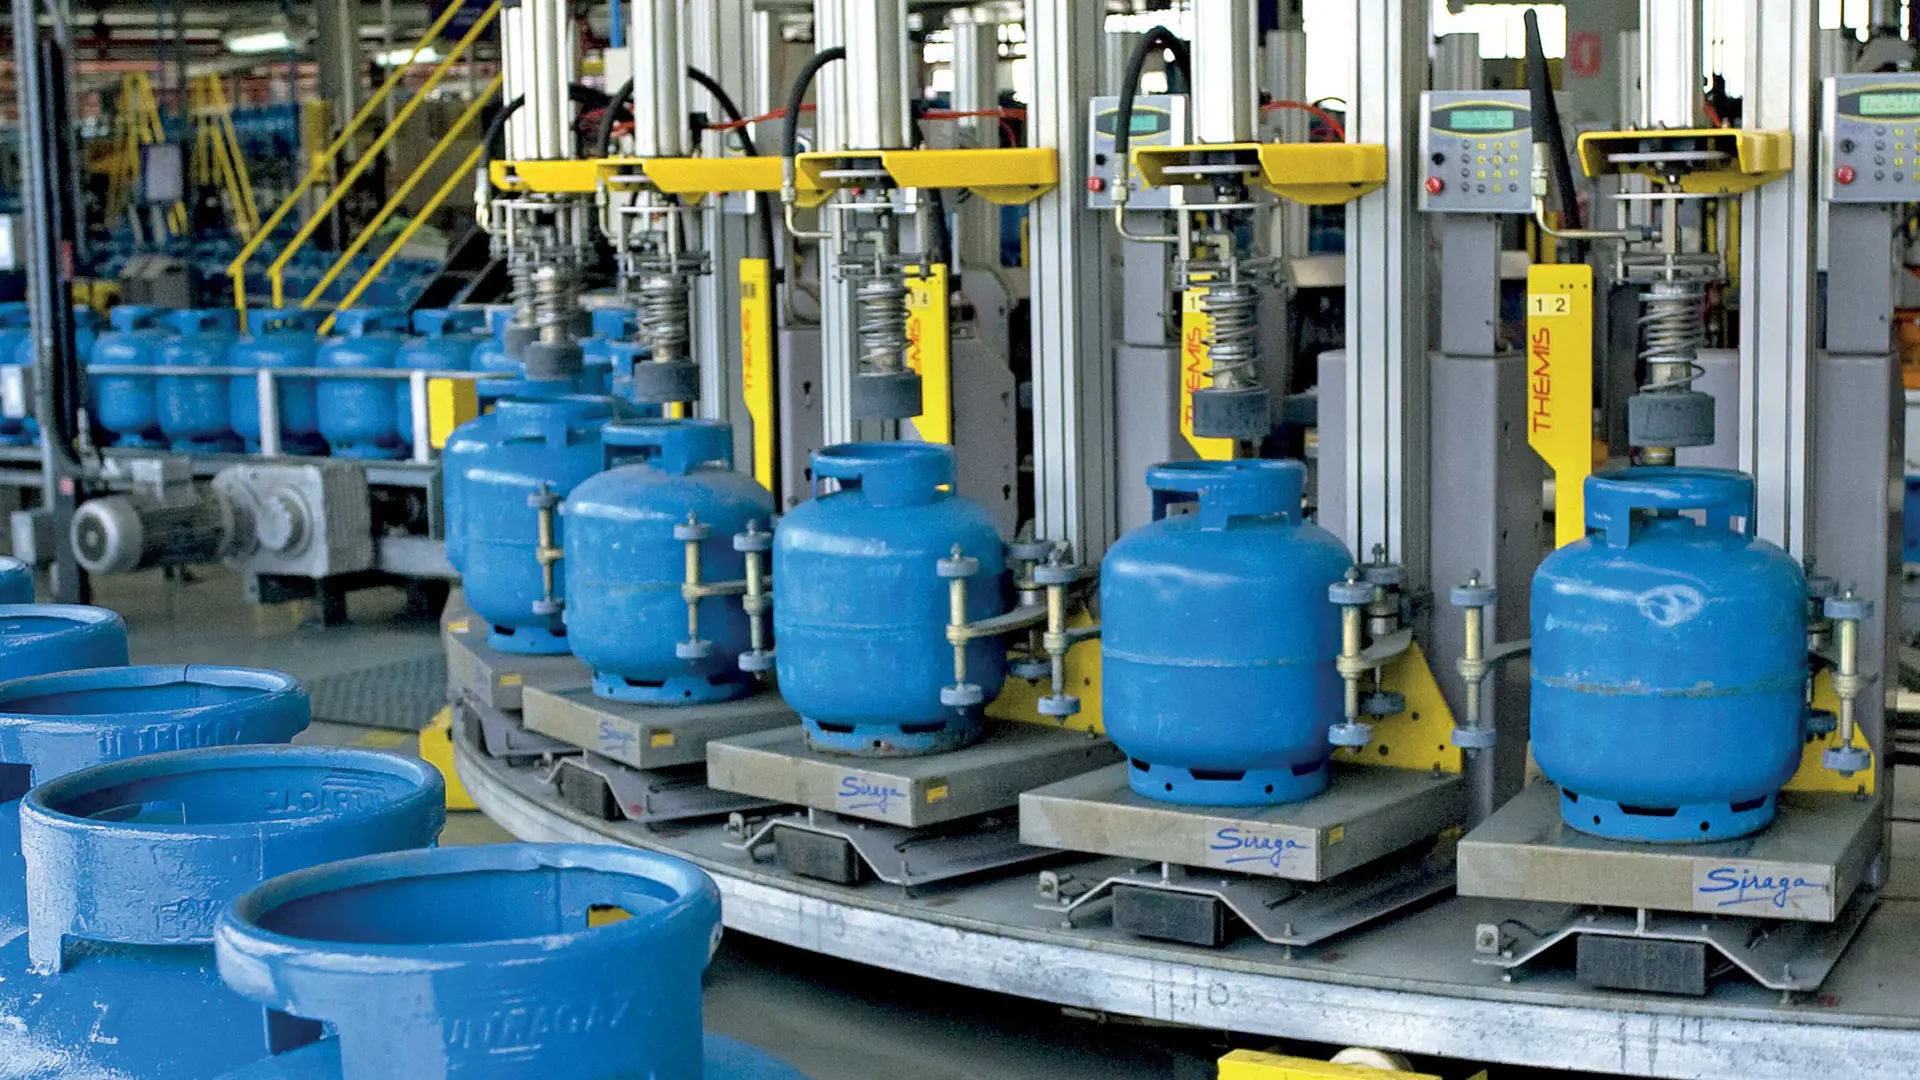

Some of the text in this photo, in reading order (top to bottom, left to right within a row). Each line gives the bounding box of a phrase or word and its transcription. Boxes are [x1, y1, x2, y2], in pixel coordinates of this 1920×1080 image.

[1532, 326, 1551, 433] THEMIS
[1210, 826, 1310, 868] Siraga
[1699, 867, 1824, 908] Siraga
